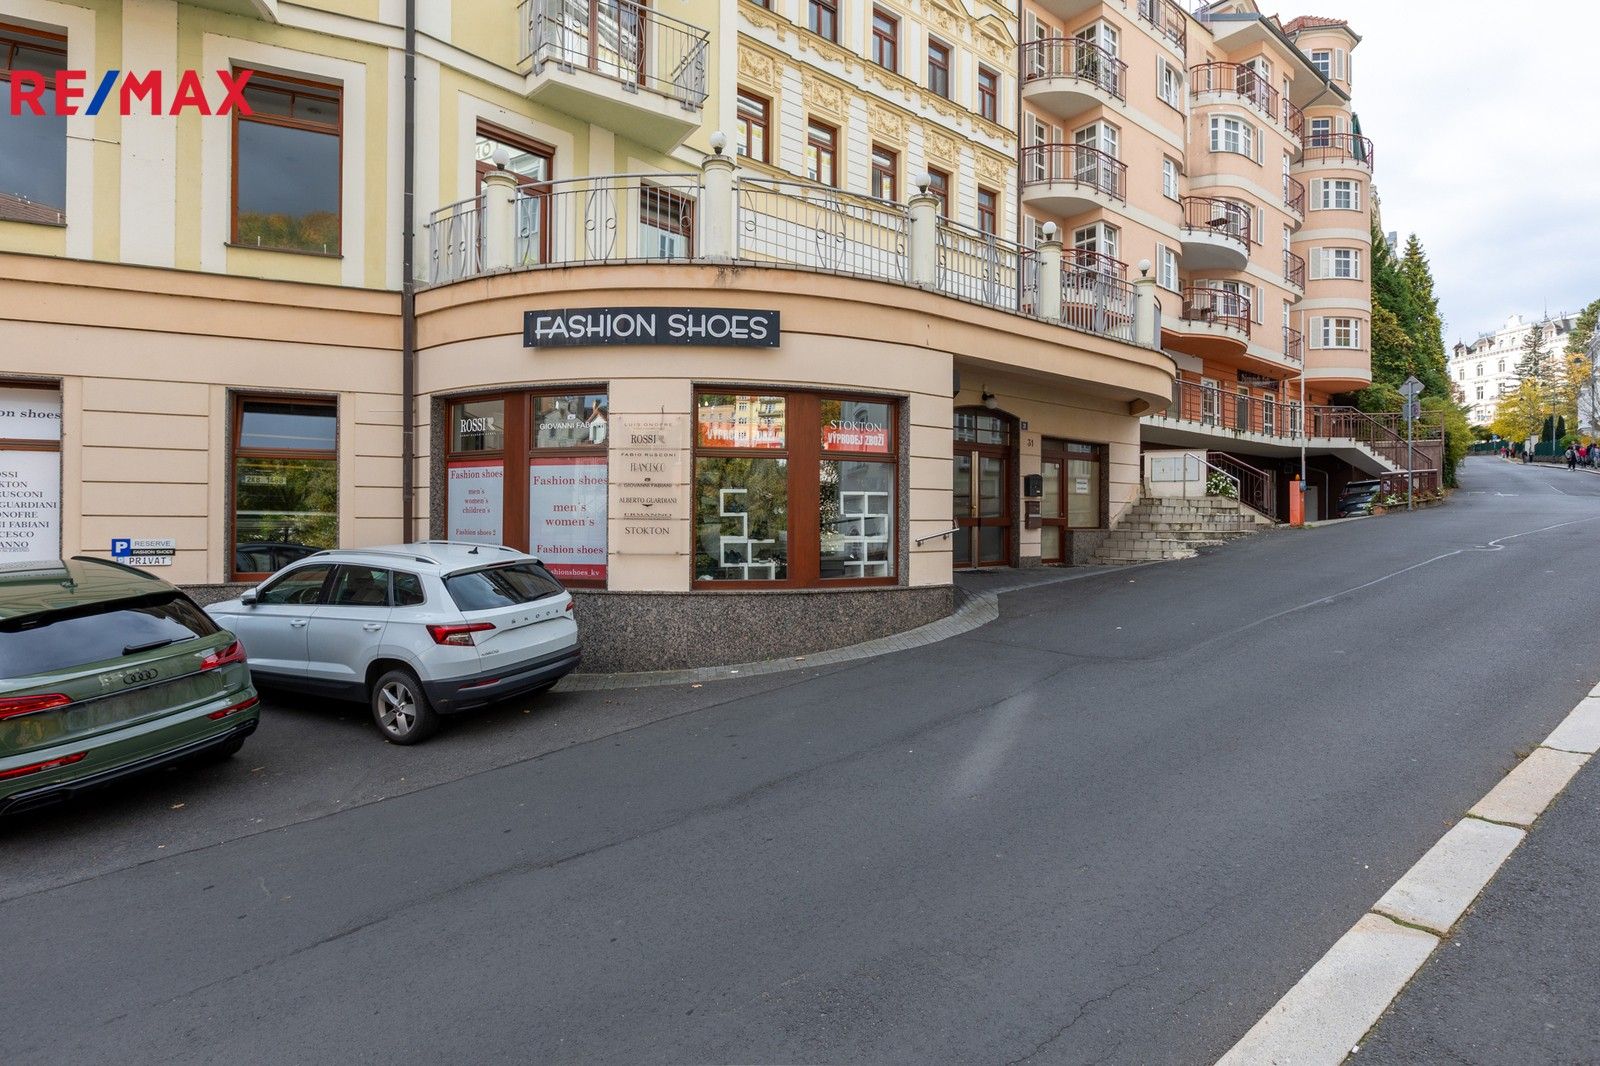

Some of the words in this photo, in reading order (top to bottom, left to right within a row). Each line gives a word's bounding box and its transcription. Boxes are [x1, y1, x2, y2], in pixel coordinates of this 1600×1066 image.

[535, 313, 656, 339] FASHION
[668, 313, 769, 340] SHOES
[20, 409, 61, 419] shoes
[460, 417, 486, 433] ROSSI
[539, 422, 575, 430] GIOVANNI
[830, 420, 883, 433] STOKTON
[630, 434, 656, 444] ROSSI
[827, 431, 863, 446] VÝPRODEJ
[865, 433, 885, 446] ZBOŽÍ
[1026, 438, 1034, 448] 31
[450, 470, 480, 479] Fashion
[481, 469, 504, 478] shoes
[533, 475, 575, 485] Fashion
[579, 475, 608, 485] shoes
[619, 496, 645, 504] ALBERTO
[646, 496, 678, 504] GUARDIANI
[456, 528, 476, 536] Fashion
[477, 528, 492, 536] shoes
[624, 526, 671, 535] STOKTON
[536, 544, 574, 553] Fashion
[577, 545, 604, 554] shoes
[129, 557, 167, 565] PRIVAT
